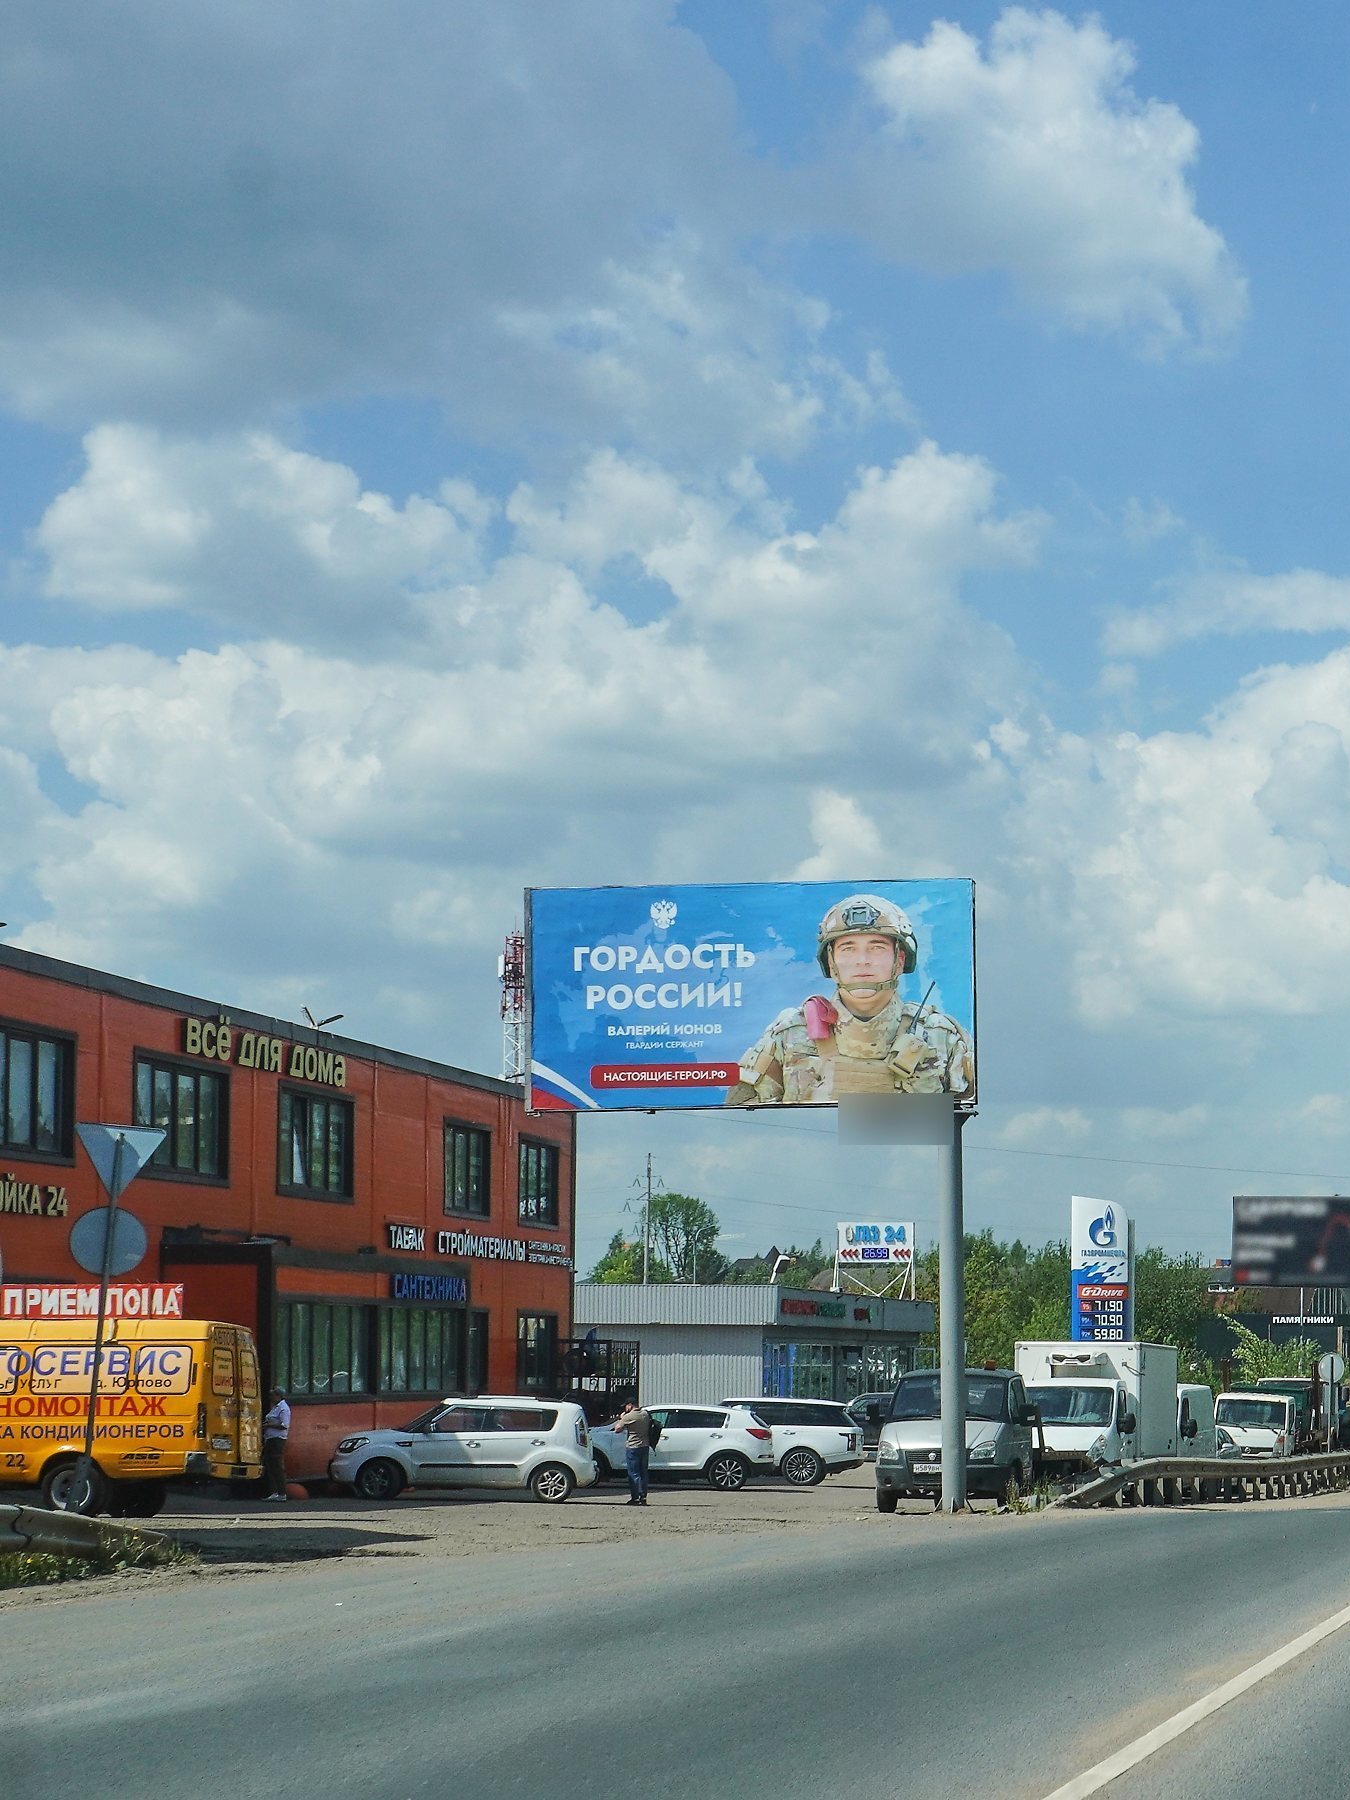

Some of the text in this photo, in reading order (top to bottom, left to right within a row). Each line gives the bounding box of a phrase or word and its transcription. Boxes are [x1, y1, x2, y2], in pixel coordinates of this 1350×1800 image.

[573, 943, 756, 974] ГОРДОСТЬ
[586, 982, 743, 1010] РОССИИ!
[607, 1022, 723, 1037] ВАЛЕРИЙ ИОНОВ
[625, 1040, 705, 1050] ГВАРДИИ СЕРЖАНТ
[603, 1070, 728, 1083] НАСТОЯЩИЕ-ГЕРОИ.РФ
[47, 1185, 68, 1217] 24
[389, 1225, 426, 1251] ТАБАК
[854, 1225, 907, 1244] ГАЗ 24
[438, 1228, 526, 1262] СТРОЙМАТЕРИАЛЫ
[863, 1248, 888, 1259] 26.99
[393, 1274, 467, 1301] САНТЕХНИКА
[3, 1287, 182, 1316] ПРИЕМ ЛОМА
[1094, 1300, 1123, 1312] 71.90
[1094, 1314, 1123, 1326] 70.90
[1272, 1316, 1334, 1324] ПАМЯТНИКИ
[1094, 1328, 1123, 1340] 59.80
[5, 1453, 25, 1468] 22
